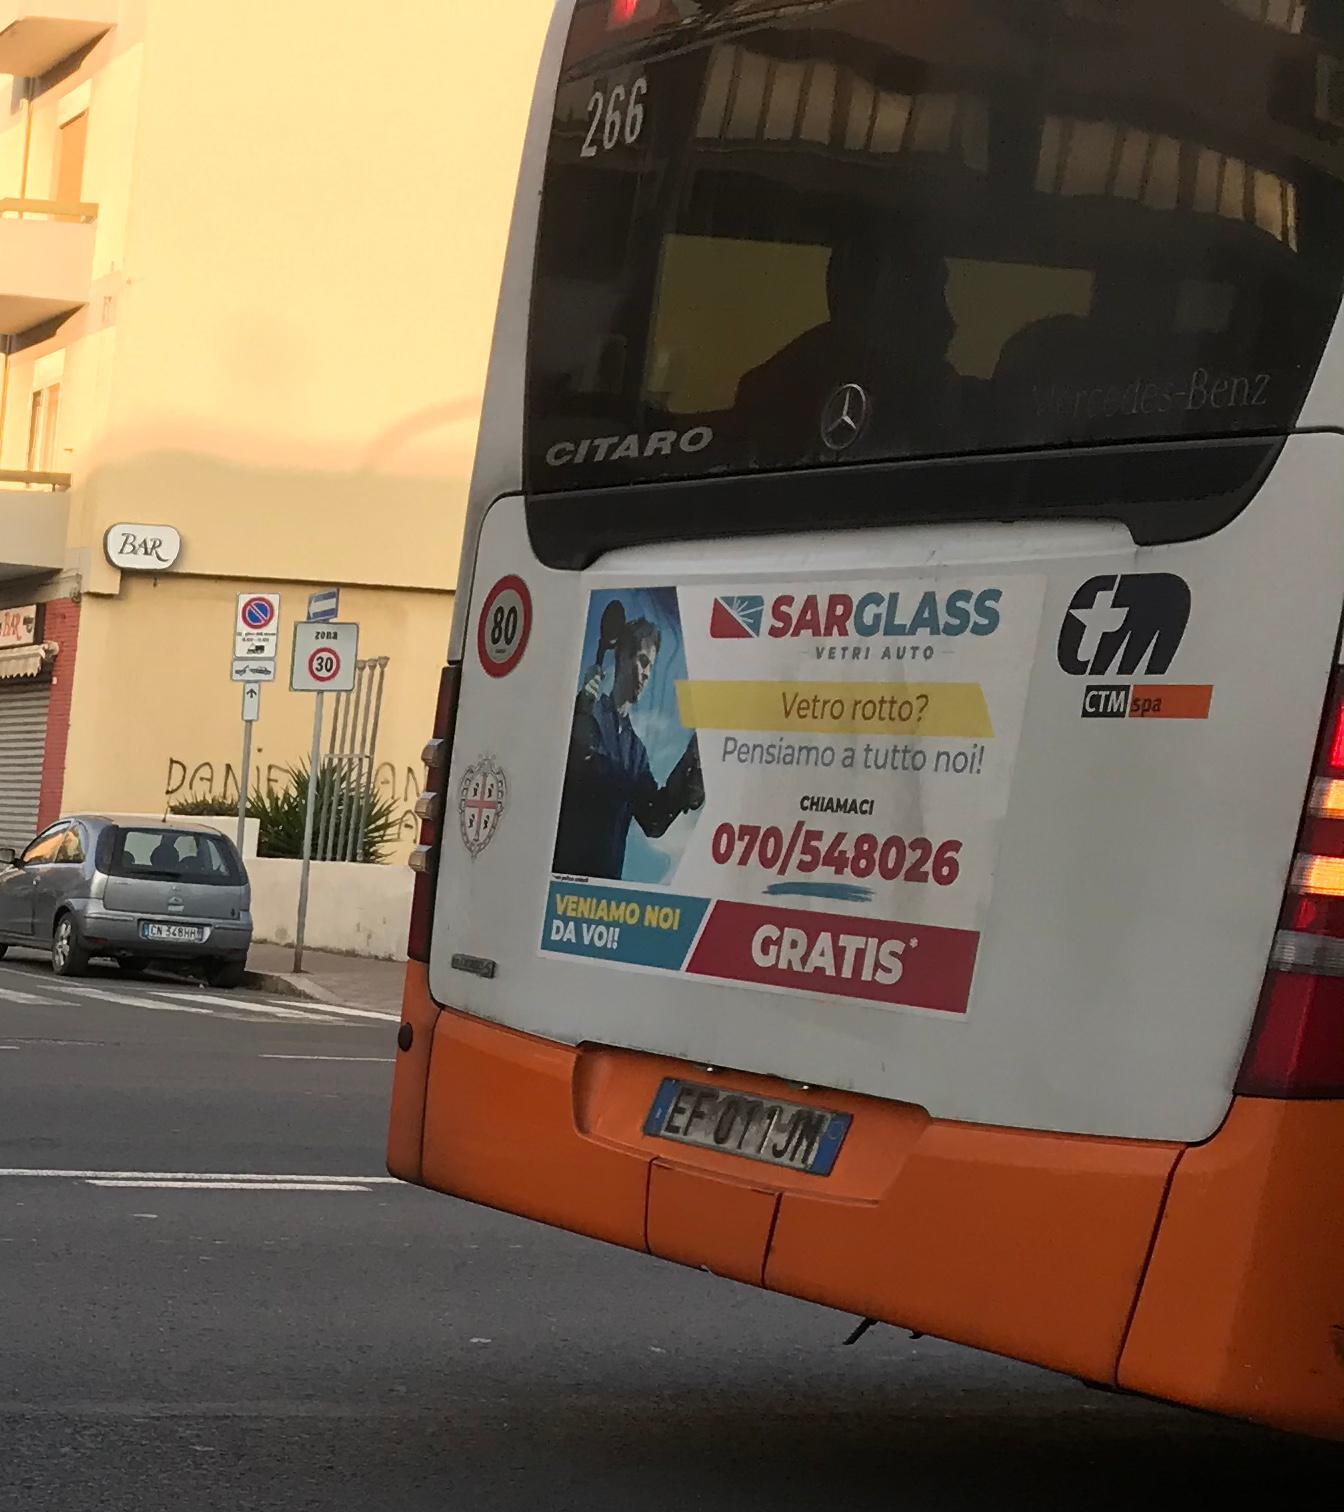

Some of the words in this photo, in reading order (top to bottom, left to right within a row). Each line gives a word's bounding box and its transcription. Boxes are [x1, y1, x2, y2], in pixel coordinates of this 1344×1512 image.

[580, 77, 648, 157] 266
[545, 426, 714, 466] CITARO
[118, 532, 169, 562] BAR
[491, 605, 518, 646] 80
[767, 588, 1003, 638] SARGLASS
[314, 631, 338, 640] zona
[315, 656, 334, 672] 30
[815, 646, 870, 660] VETRI
[881, 645, 935, 660] AUTO
[781, 691, 845, 720] Vetro
[851, 694, 930, 723] rotto?
[1085, 690, 1126, 713] CTM
[1131, 696, 1163, 717] spa
[721, 736, 836, 768] Pensiamo
[841, 748, 855, 768] a
[862, 744, 927, 771] tutto
[933, 744, 986, 775] noi!
[799, 795, 875, 816] CHIAMACI
[711, 820, 963, 886] 070/548026
[555, 893, 640, 925] VENIAMO
[644, 904, 681, 931] NOI
[150, 924, 162, 936] CN
[550, 919, 576, 943] DA
[582, 923, 620, 950] VOI!
